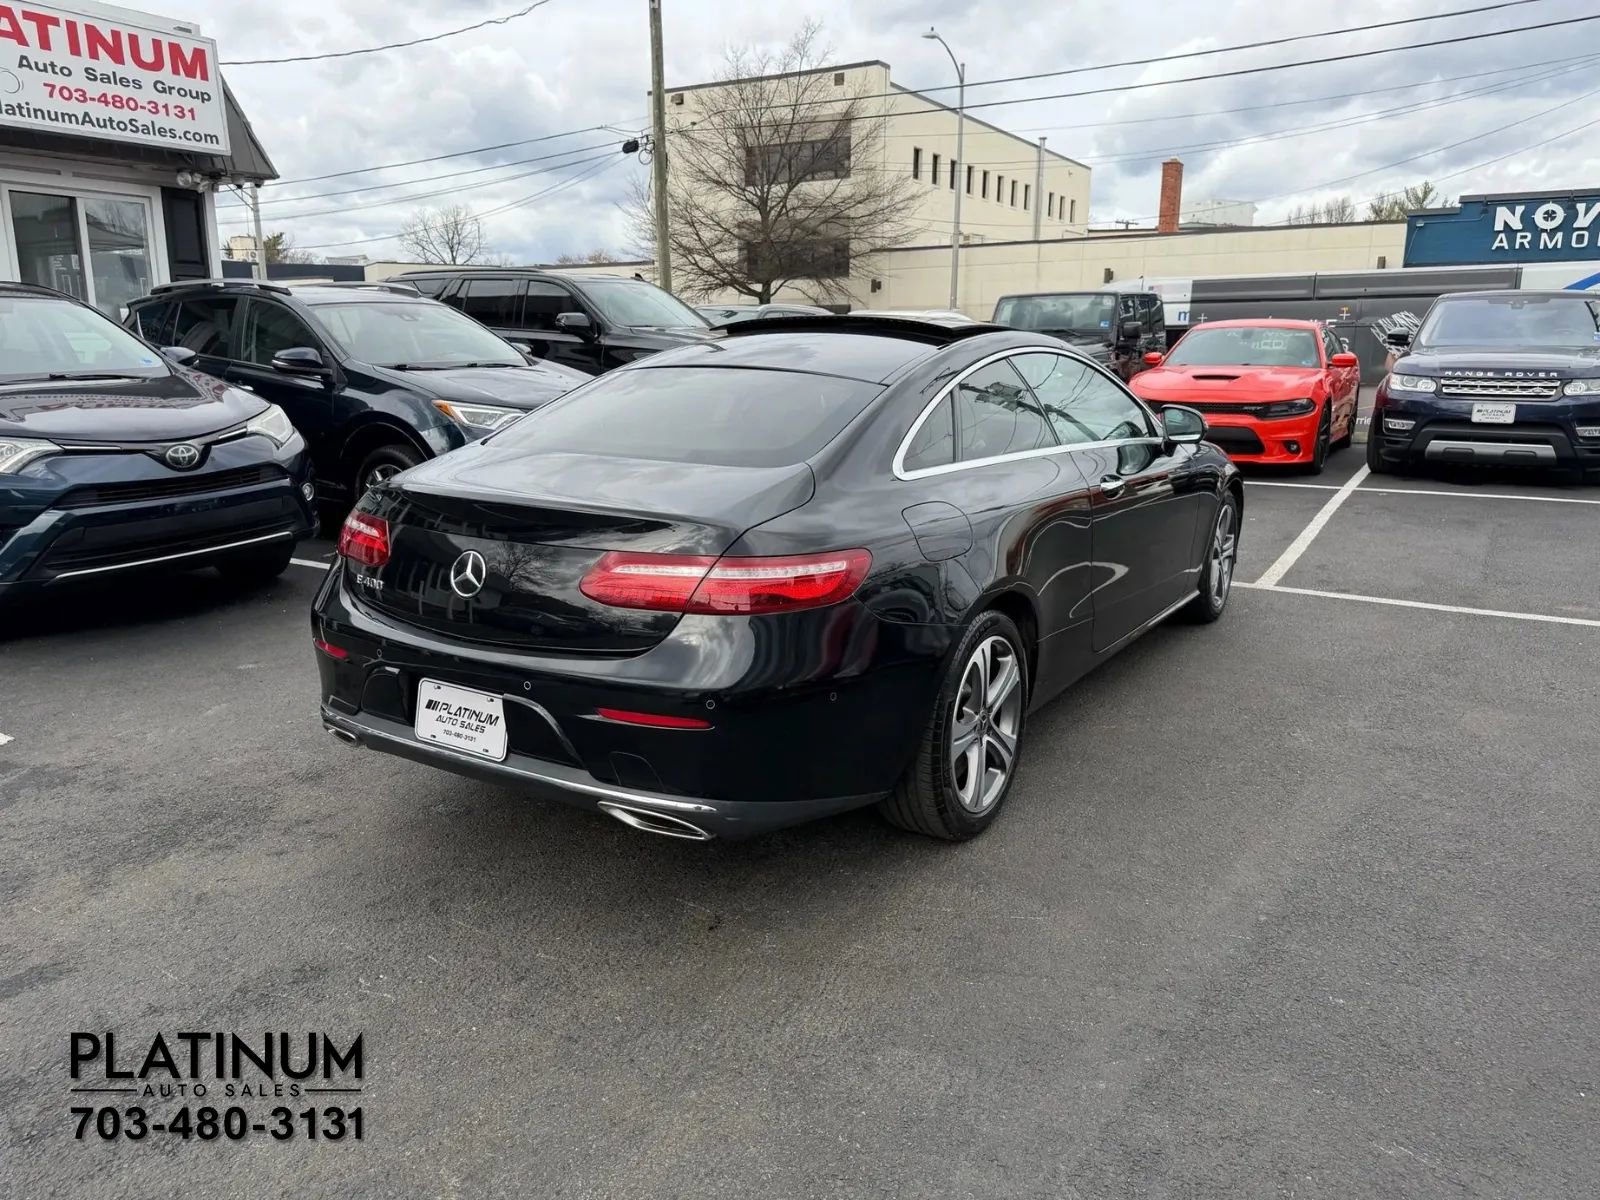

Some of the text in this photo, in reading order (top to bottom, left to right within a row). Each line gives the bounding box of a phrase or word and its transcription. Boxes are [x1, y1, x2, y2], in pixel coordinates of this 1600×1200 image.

[18, 54, 212, 104] Auto Sales Group
[43, 82, 196, 121] 703-480-3131
[1491, 231, 1600, 250] ARMO
[435, 714, 486, 734] AUTO SALES
[439, 702, 499, 727] PLATINUM
